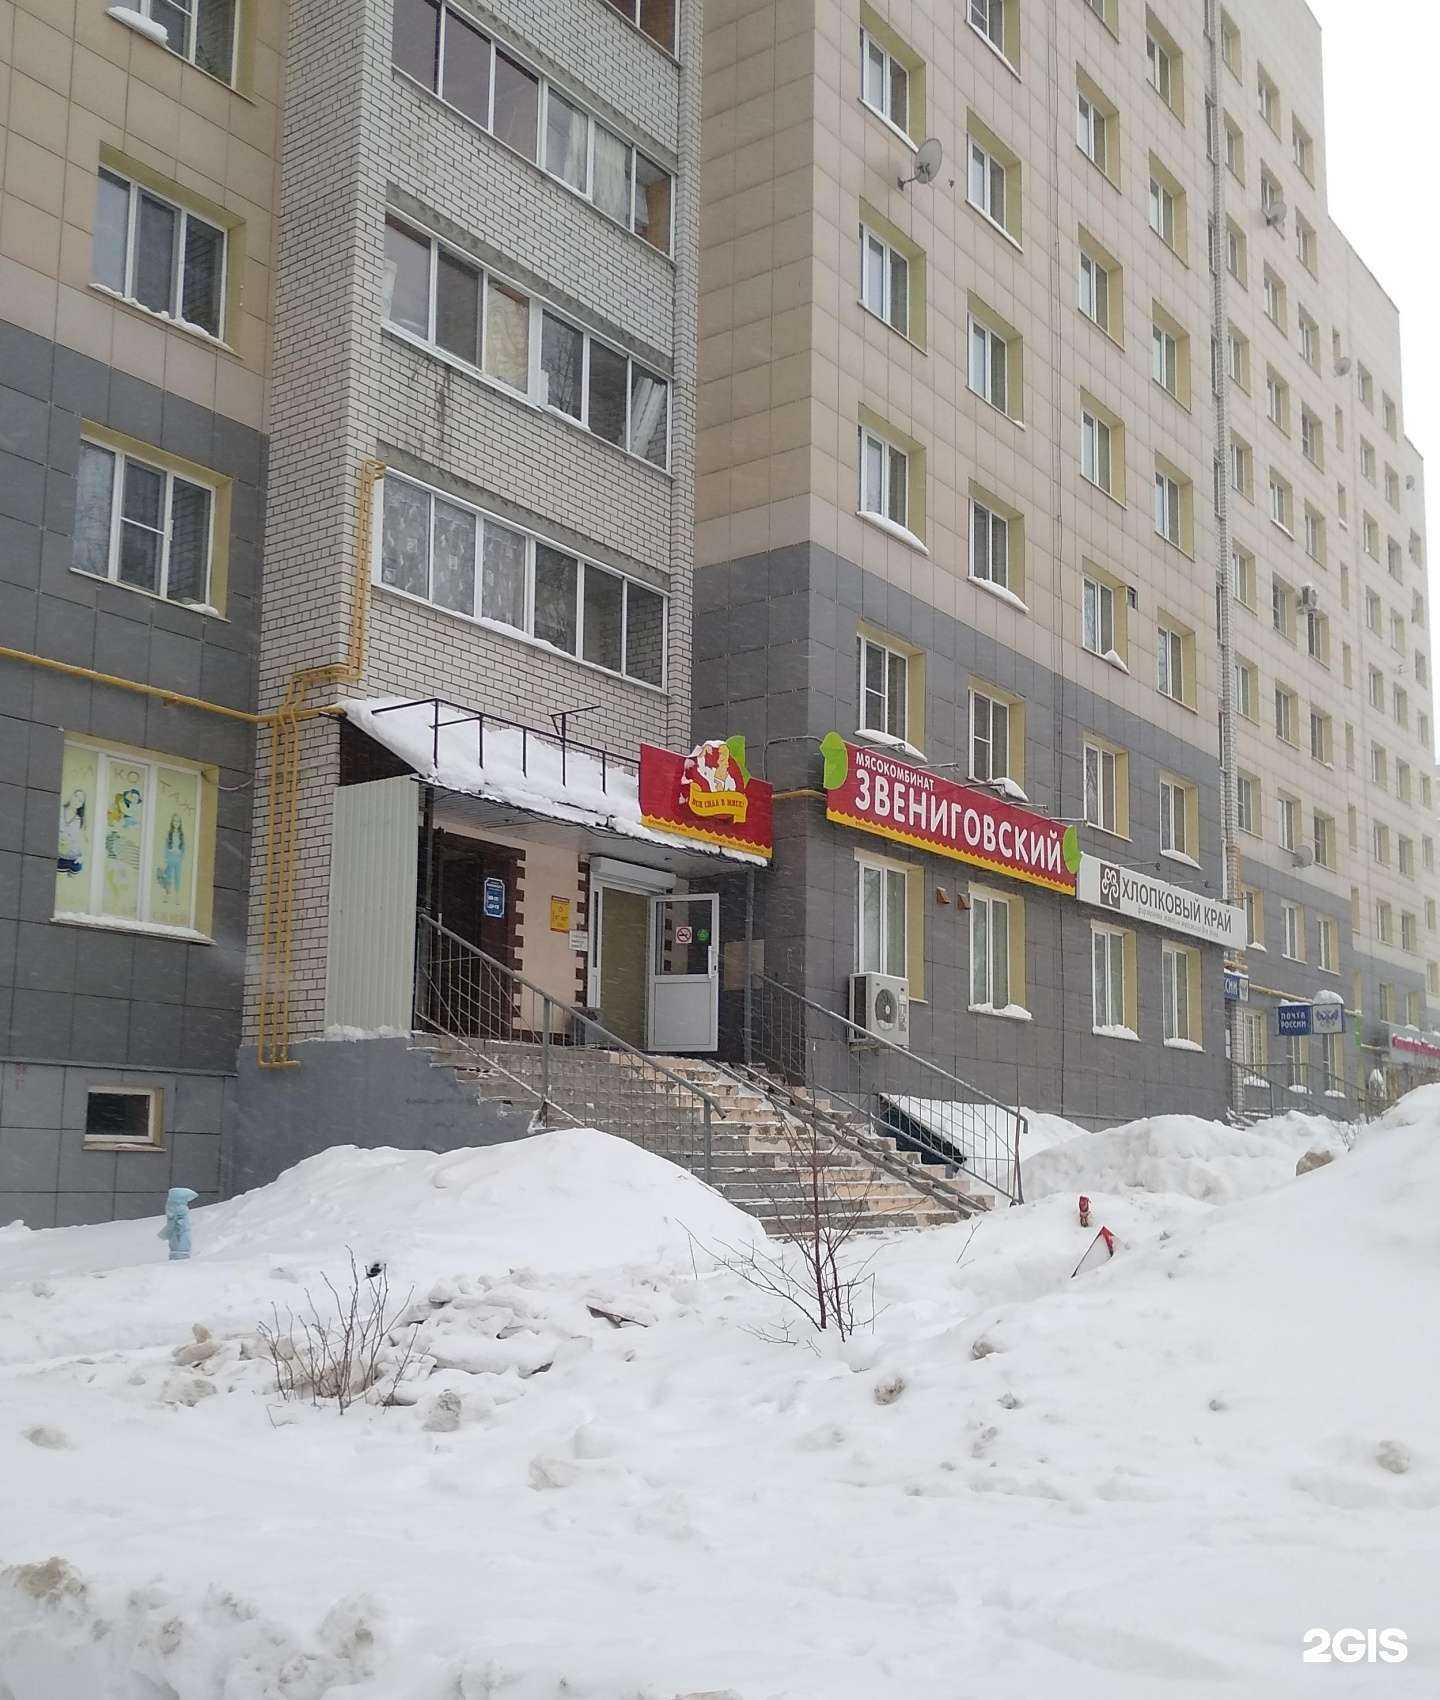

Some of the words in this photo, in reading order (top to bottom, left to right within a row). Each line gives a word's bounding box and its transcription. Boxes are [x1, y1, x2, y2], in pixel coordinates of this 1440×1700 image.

[855, 752, 935, 790] МЯСОКОМБИНАТ
[854, 768, 1062, 875] ЗВЕНИГОВСКИЙ
[1121, 876, 1201, 924] ХЛОПКОВЫЙ
[1204, 905, 1232, 934] КРАЙ
[1280, 1011, 1306, 1021] ПОЧТА
[1280, 1020, 1307, 1029] РОССИИ
